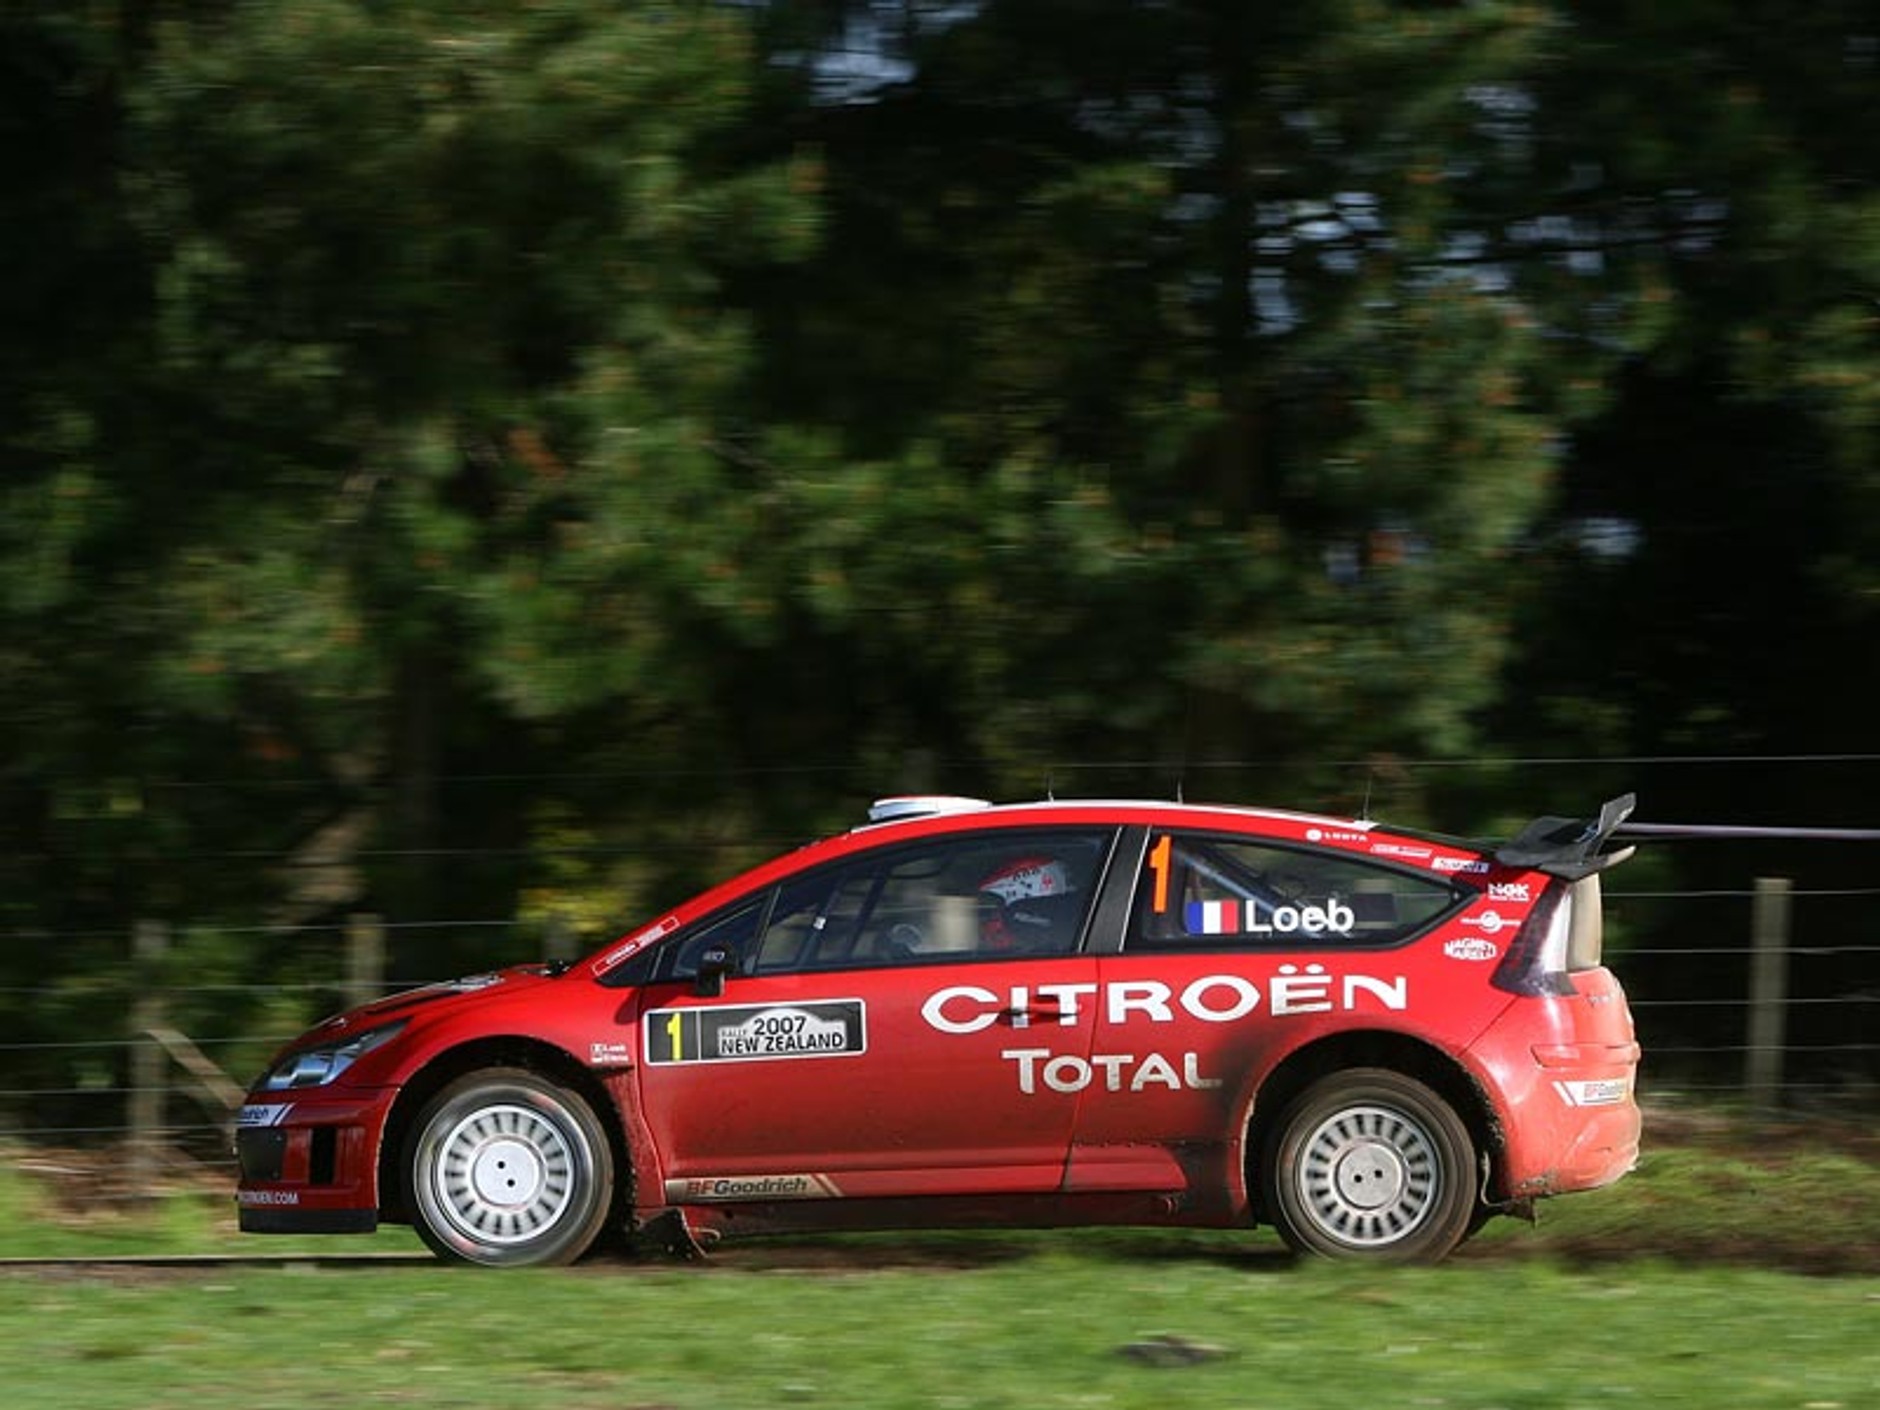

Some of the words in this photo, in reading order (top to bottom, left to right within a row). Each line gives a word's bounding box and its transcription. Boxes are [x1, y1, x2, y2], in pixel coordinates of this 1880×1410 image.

[1150, 834, 1171, 913] 1
[1245, 899, 1354, 932] Loeb
[921, 964, 1407, 1034] CITROËN
[667, 1012, 682, 1062] 1
[754, 1016, 807, 1035] 2007
[721, 1037, 760, 1054] NEW
[765, 1032, 844, 1051] ZEALAND
[686, 1177, 807, 1195] BFGoodrich
